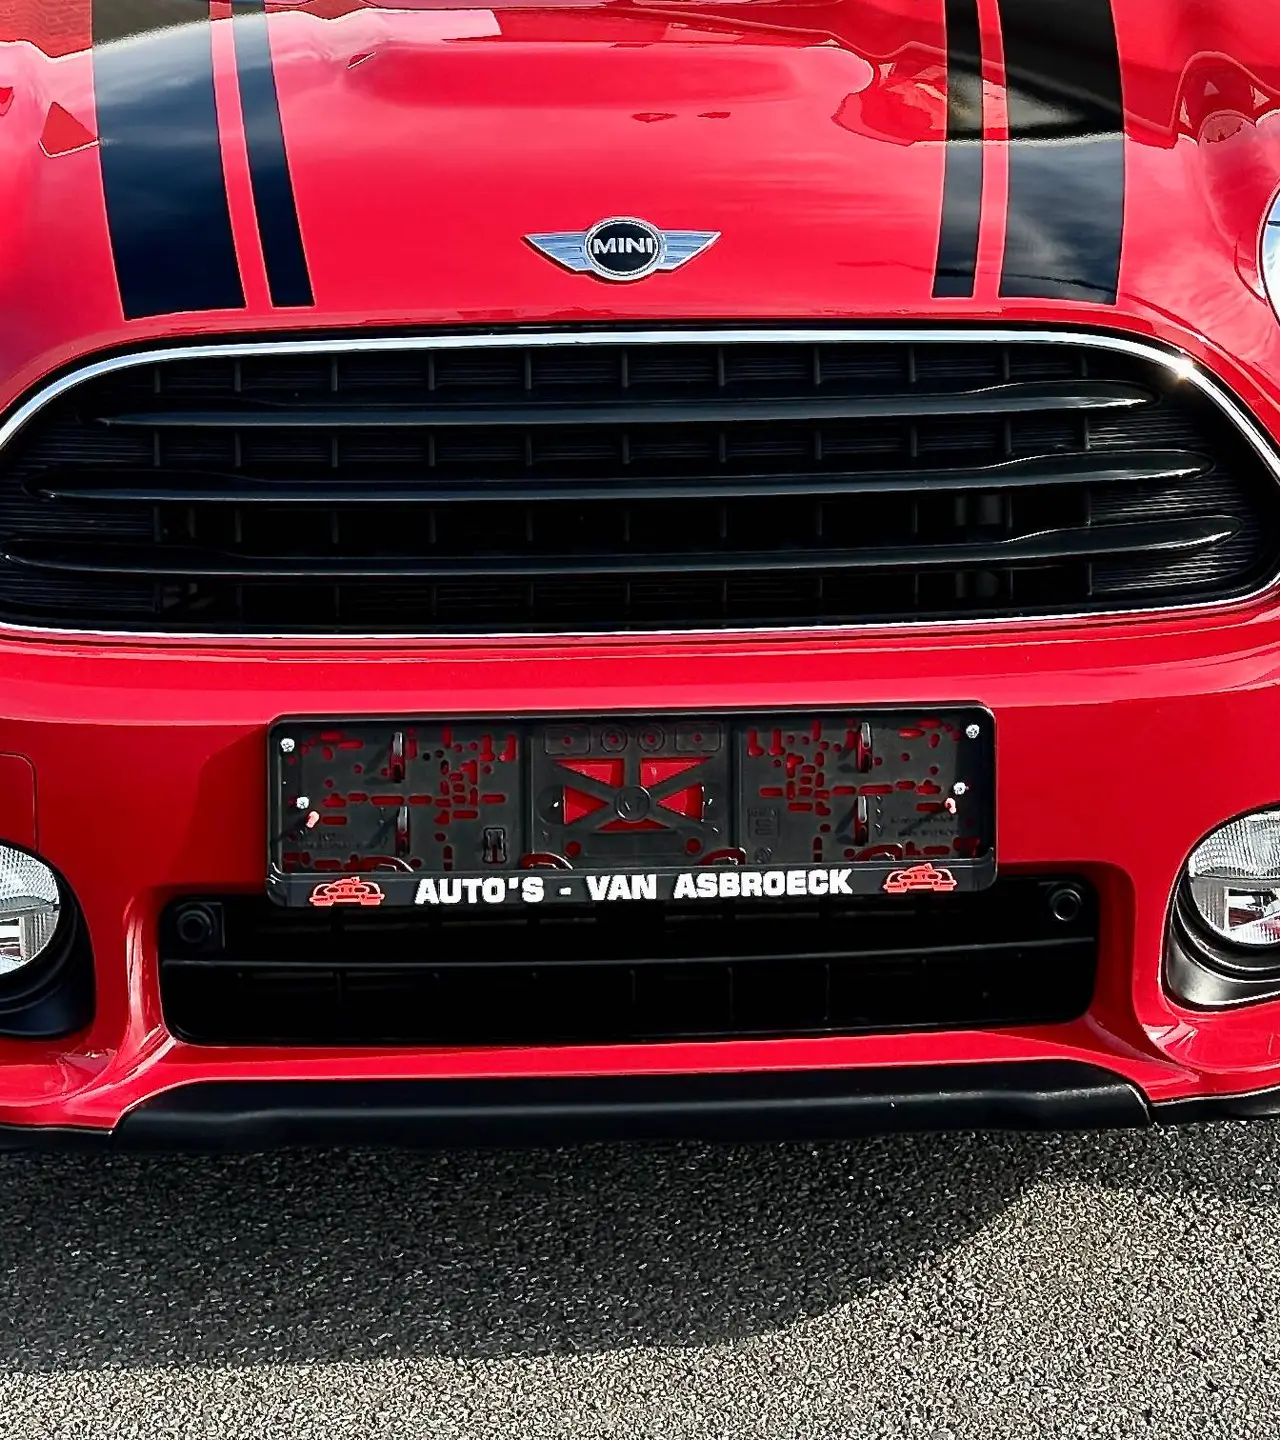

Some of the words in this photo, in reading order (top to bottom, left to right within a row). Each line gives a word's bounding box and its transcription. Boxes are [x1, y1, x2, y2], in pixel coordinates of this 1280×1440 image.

[593, 237, 653, 255] MINI
[414, 876, 545, 905] AUTO'S
[585, 874, 657, 902] VAN
[673, 868, 854, 899] ASBROECK
